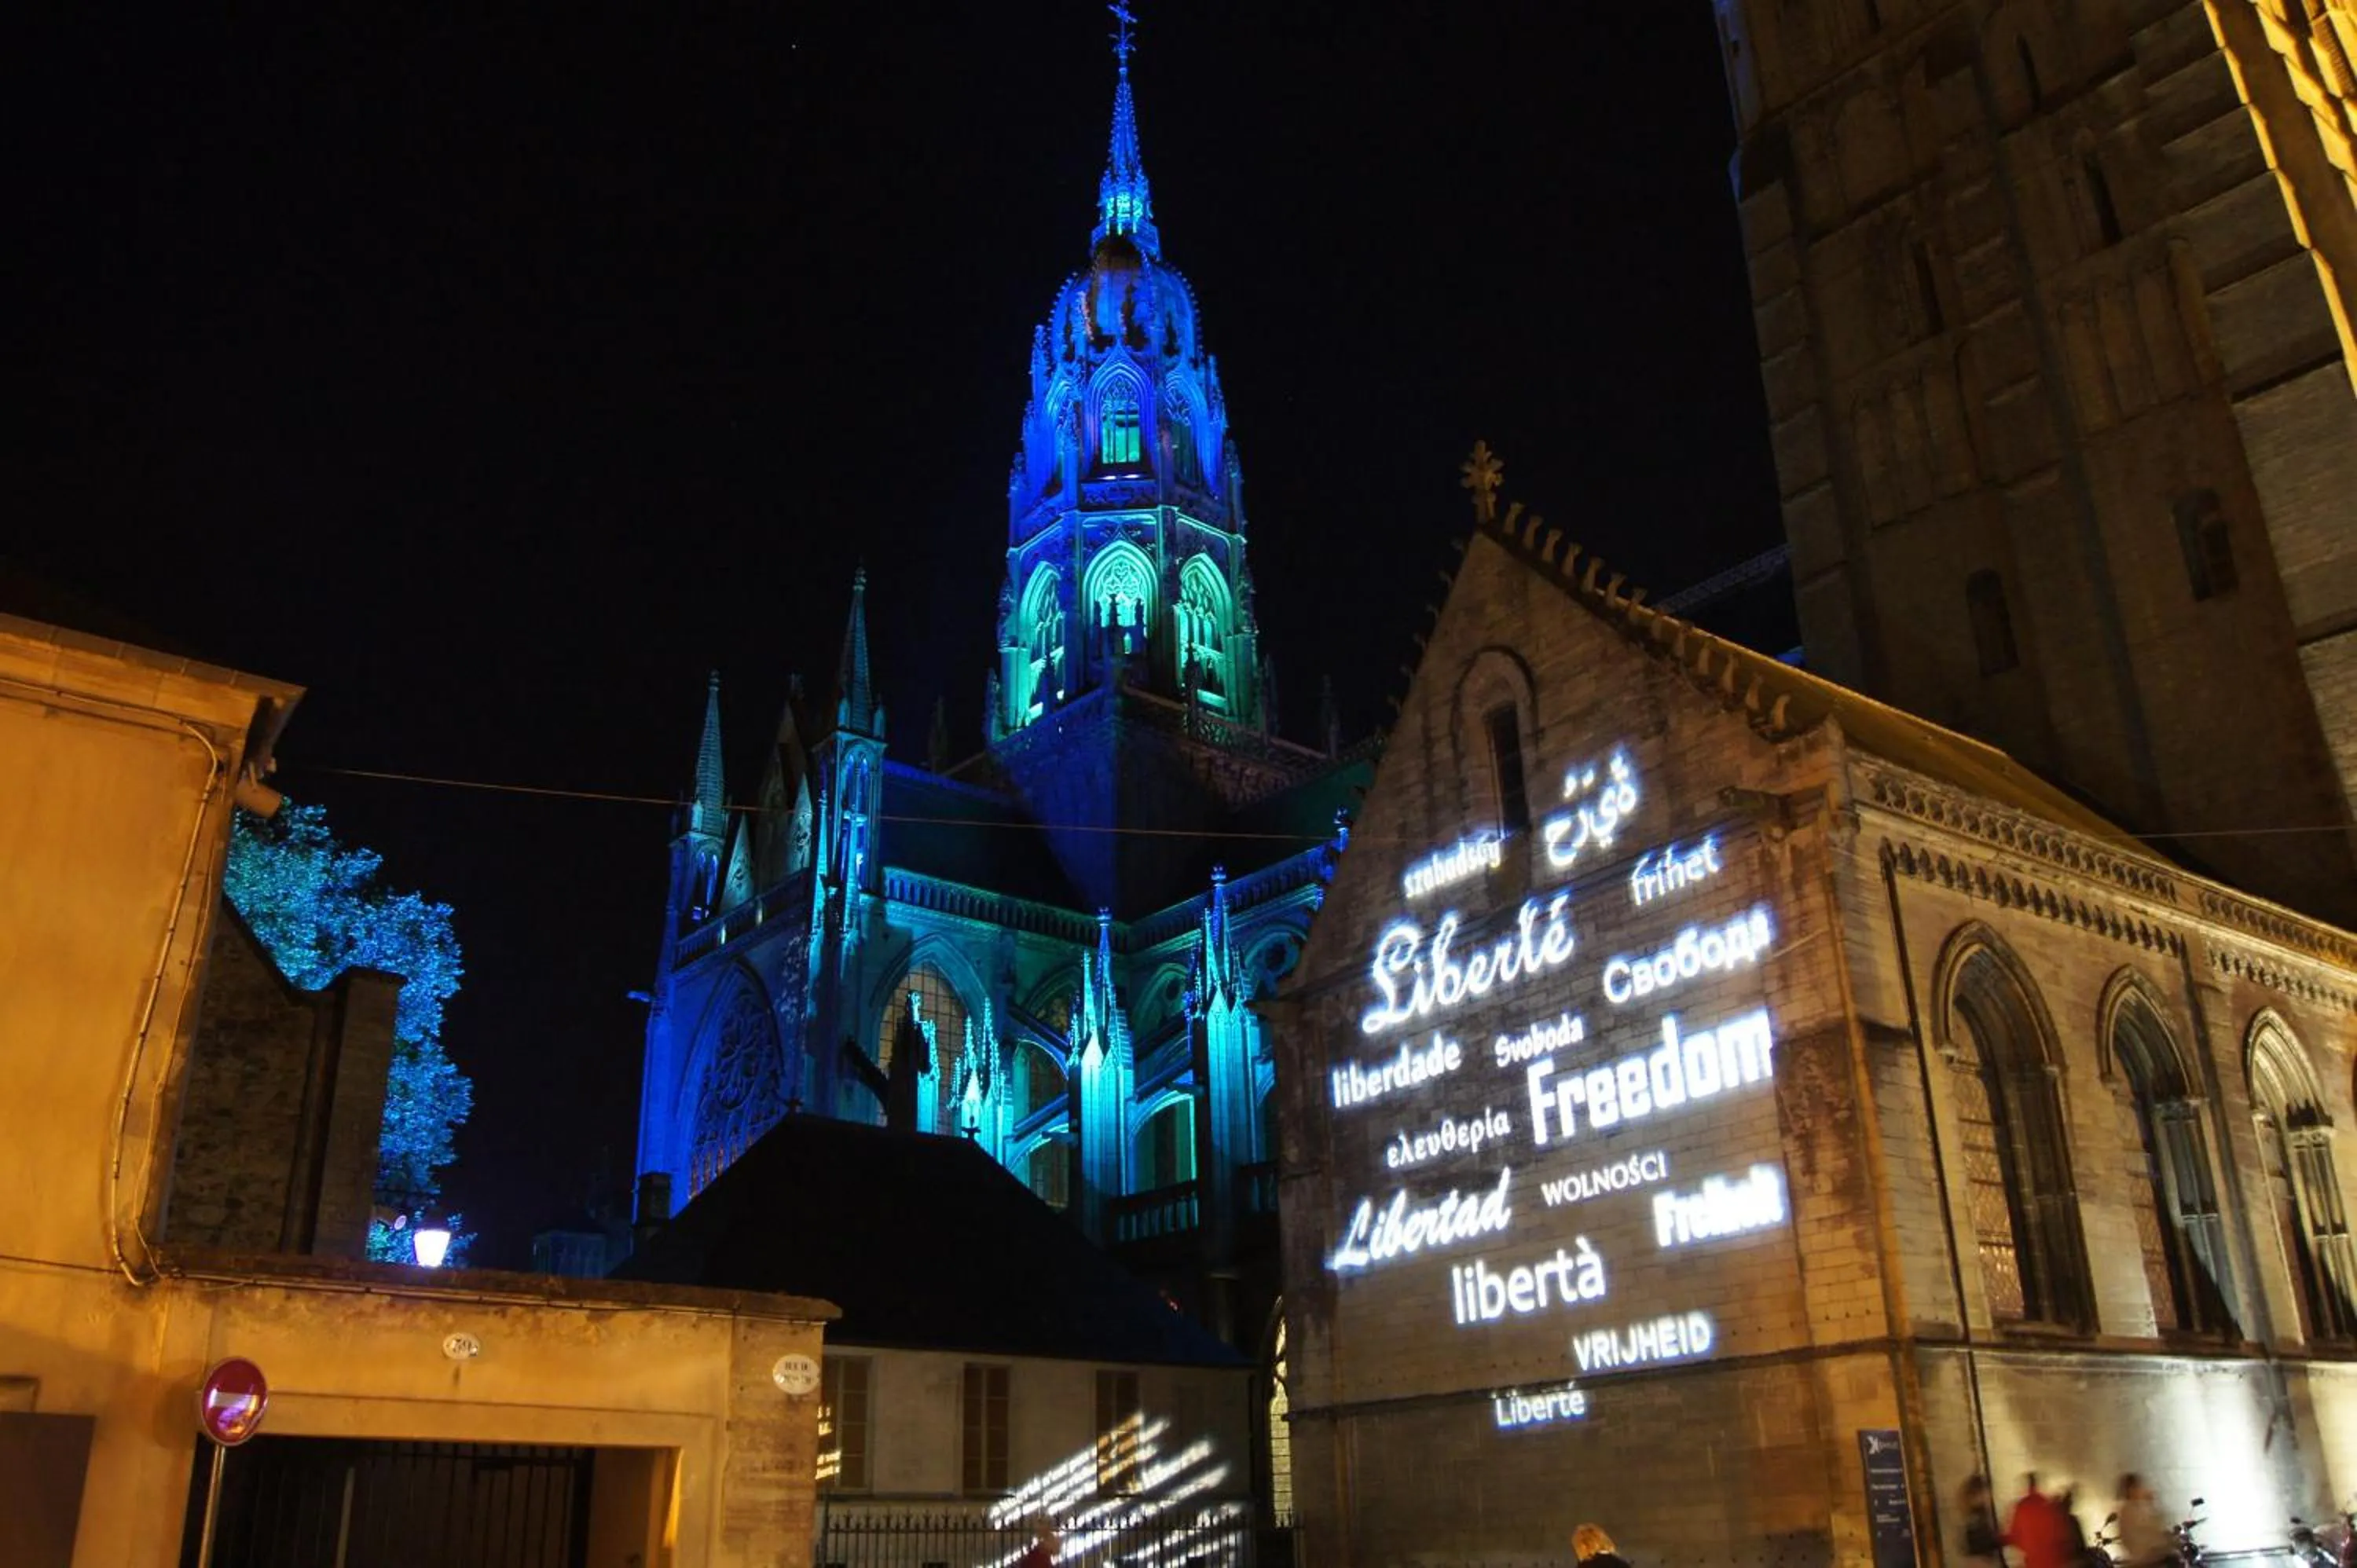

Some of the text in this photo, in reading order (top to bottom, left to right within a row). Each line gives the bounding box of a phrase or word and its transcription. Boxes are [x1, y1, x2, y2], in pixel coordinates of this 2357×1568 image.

[1630, 833, 1721, 907] frihet
[1361, 891, 1576, 1034] Liberté
[1603, 906, 1772, 1004] Свобода
[1332, 1031, 1463, 1108] liberdade
[1494, 1012, 1584, 1068] Svoboda
[1527, 1009, 1774, 1145] Freedom
[1386, 1105, 1511, 1168] ελευθερία
[1541, 1149, 1666, 1207] WOLNOŚCI
[1326, 1166, 1512, 1269] Libertad
[1452, 1235, 1606, 1324] libertà
[1572, 1313, 1713, 1372] VRIJHEID
